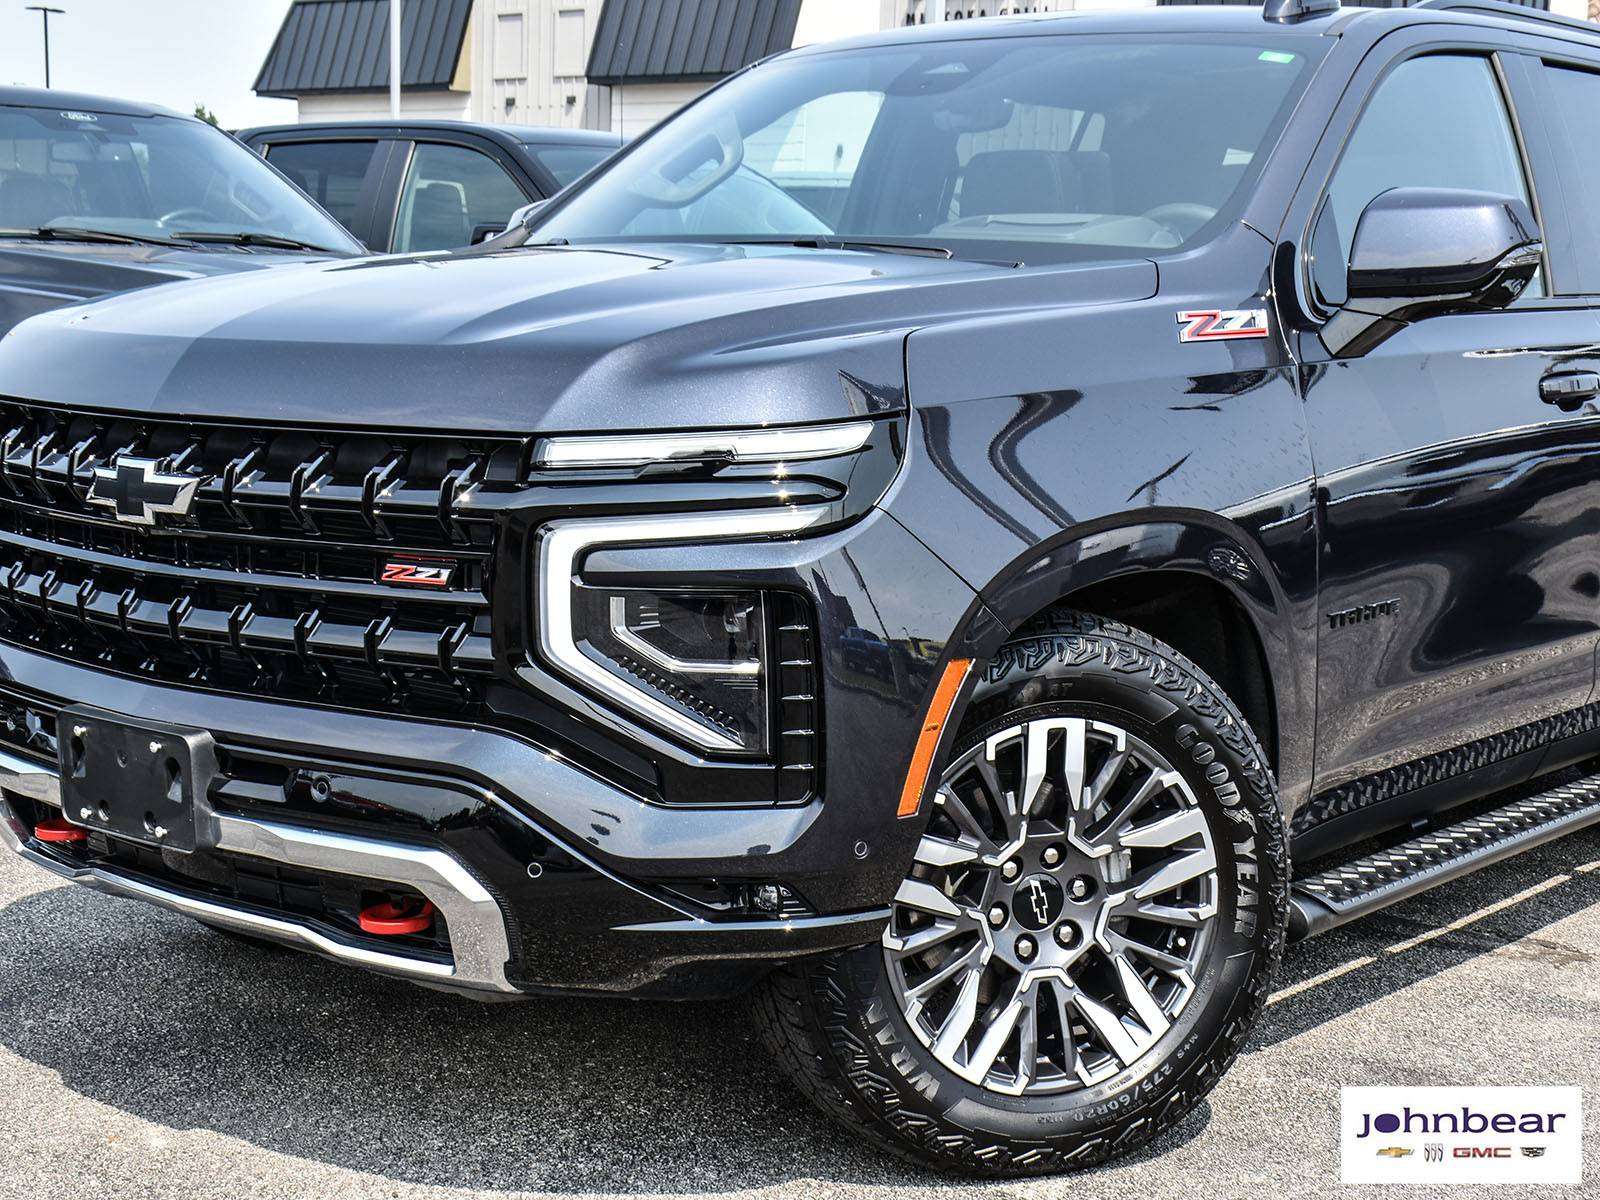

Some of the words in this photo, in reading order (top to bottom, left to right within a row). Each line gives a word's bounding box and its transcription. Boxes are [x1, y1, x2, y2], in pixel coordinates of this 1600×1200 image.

[1175, 309, 1269, 343] Z71
[381, 563, 452, 585] Z71
[1072, 1062, 1174, 1122] 275/60R20
